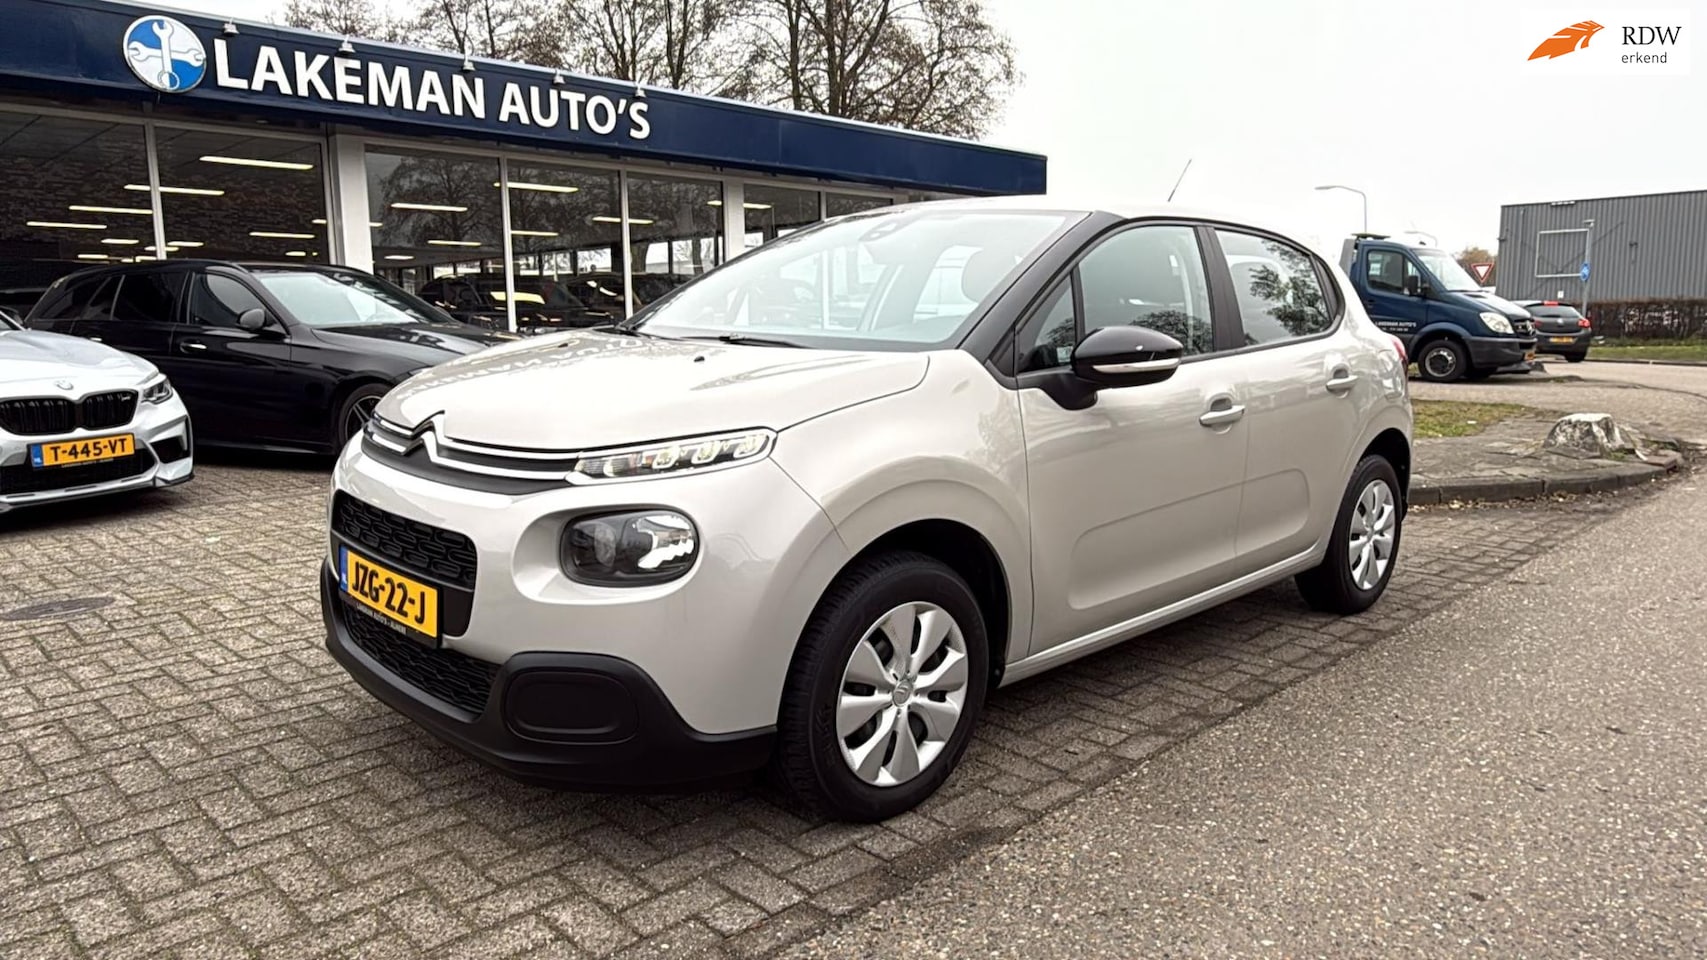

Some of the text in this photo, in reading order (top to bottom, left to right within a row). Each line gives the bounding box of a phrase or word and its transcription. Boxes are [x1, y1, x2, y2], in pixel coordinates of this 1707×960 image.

[213, 38, 651, 140] LAKEMAN AUTO'S
[50, 438, 127, 462] T-445-VT
[352, 561, 425, 624] JZG-22-J
